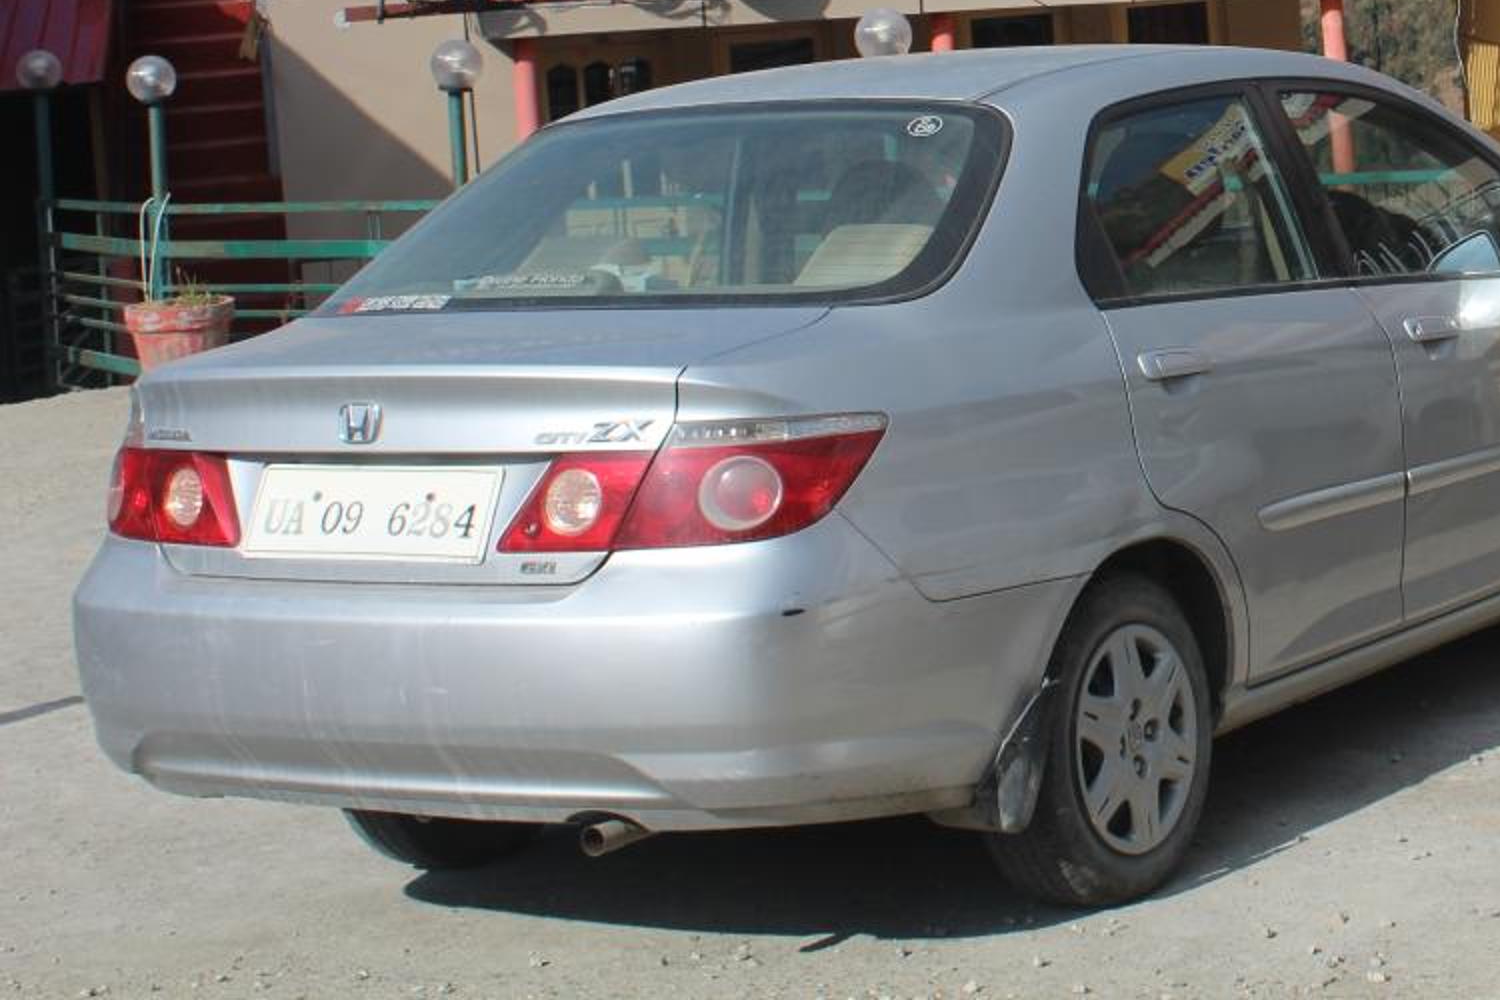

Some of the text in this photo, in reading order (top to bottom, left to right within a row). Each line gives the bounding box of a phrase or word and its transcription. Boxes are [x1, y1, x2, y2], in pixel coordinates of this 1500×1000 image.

[264, 498, 476, 538] UA 09 6284
